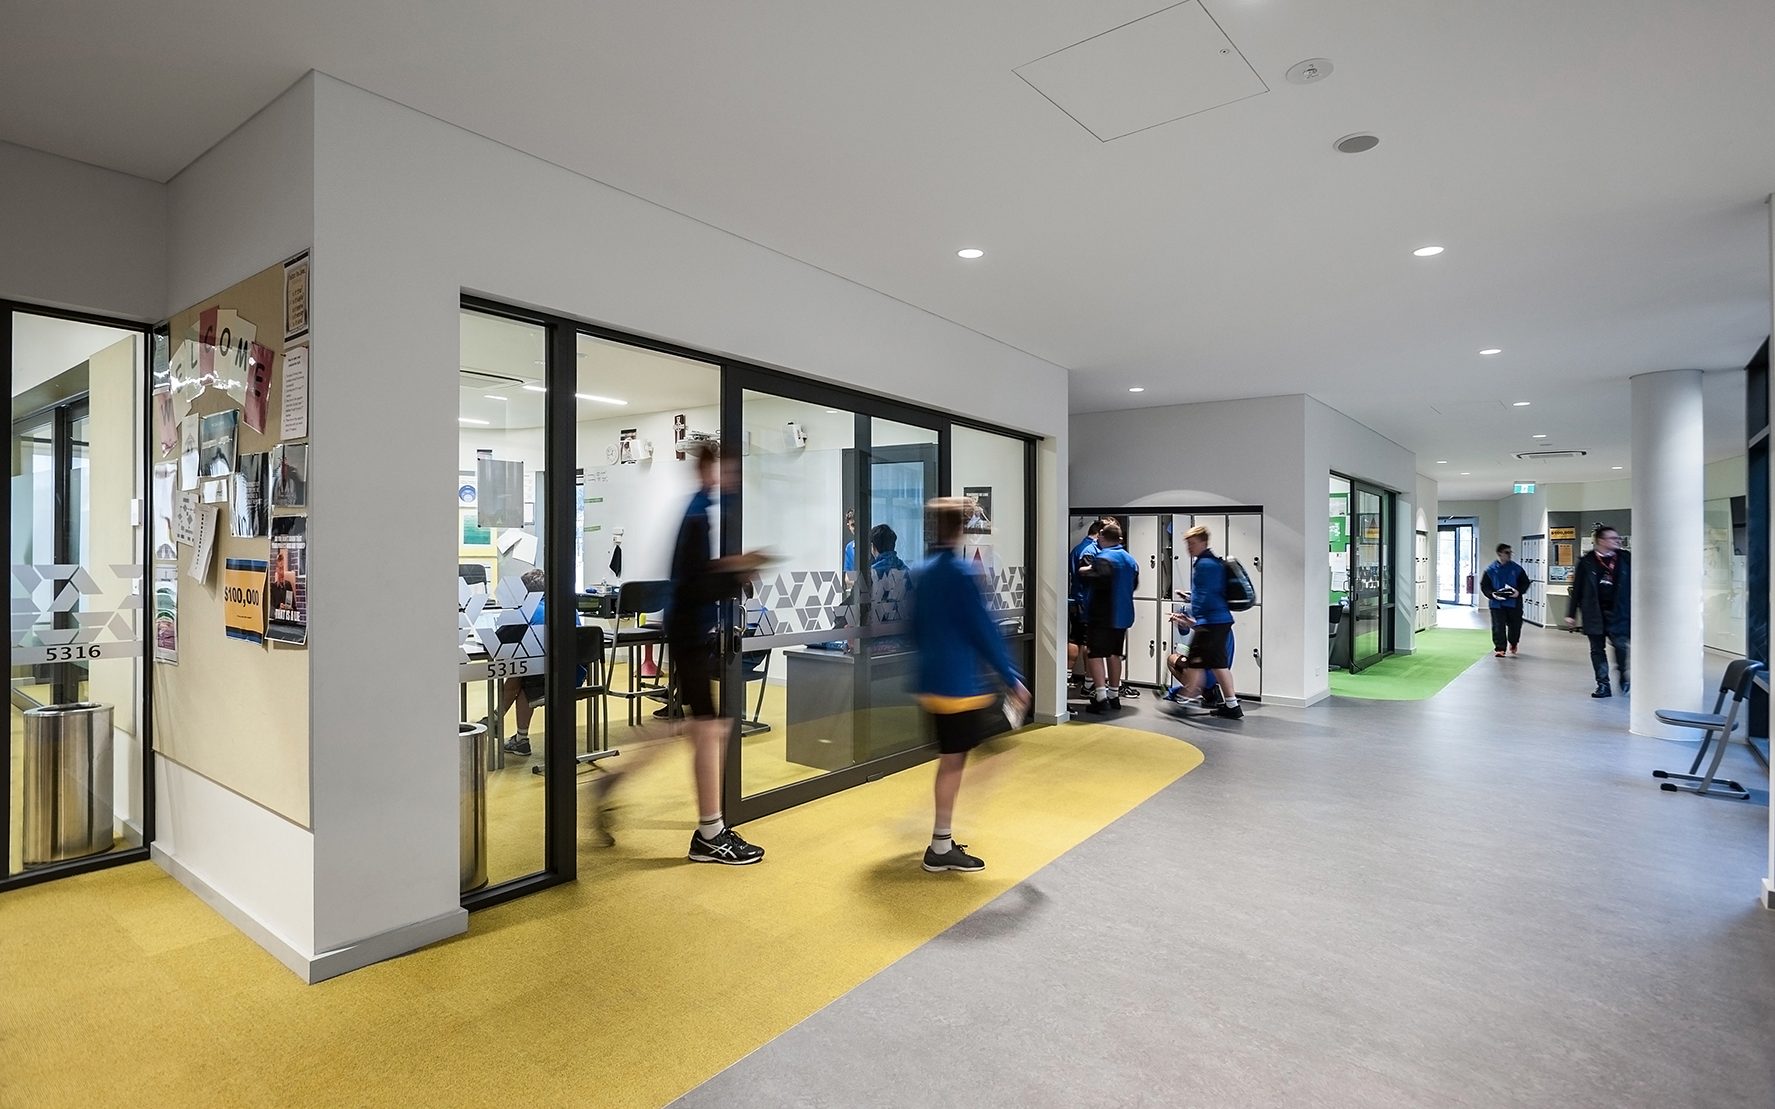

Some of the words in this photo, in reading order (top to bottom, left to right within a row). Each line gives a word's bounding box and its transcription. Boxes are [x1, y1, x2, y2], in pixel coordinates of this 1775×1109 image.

[159, 325, 266, 426] WELCOME
[224, 586, 259, 607] $100,000
[46, 644, 101, 661] 5316
[487, 660, 528, 678] 5315
